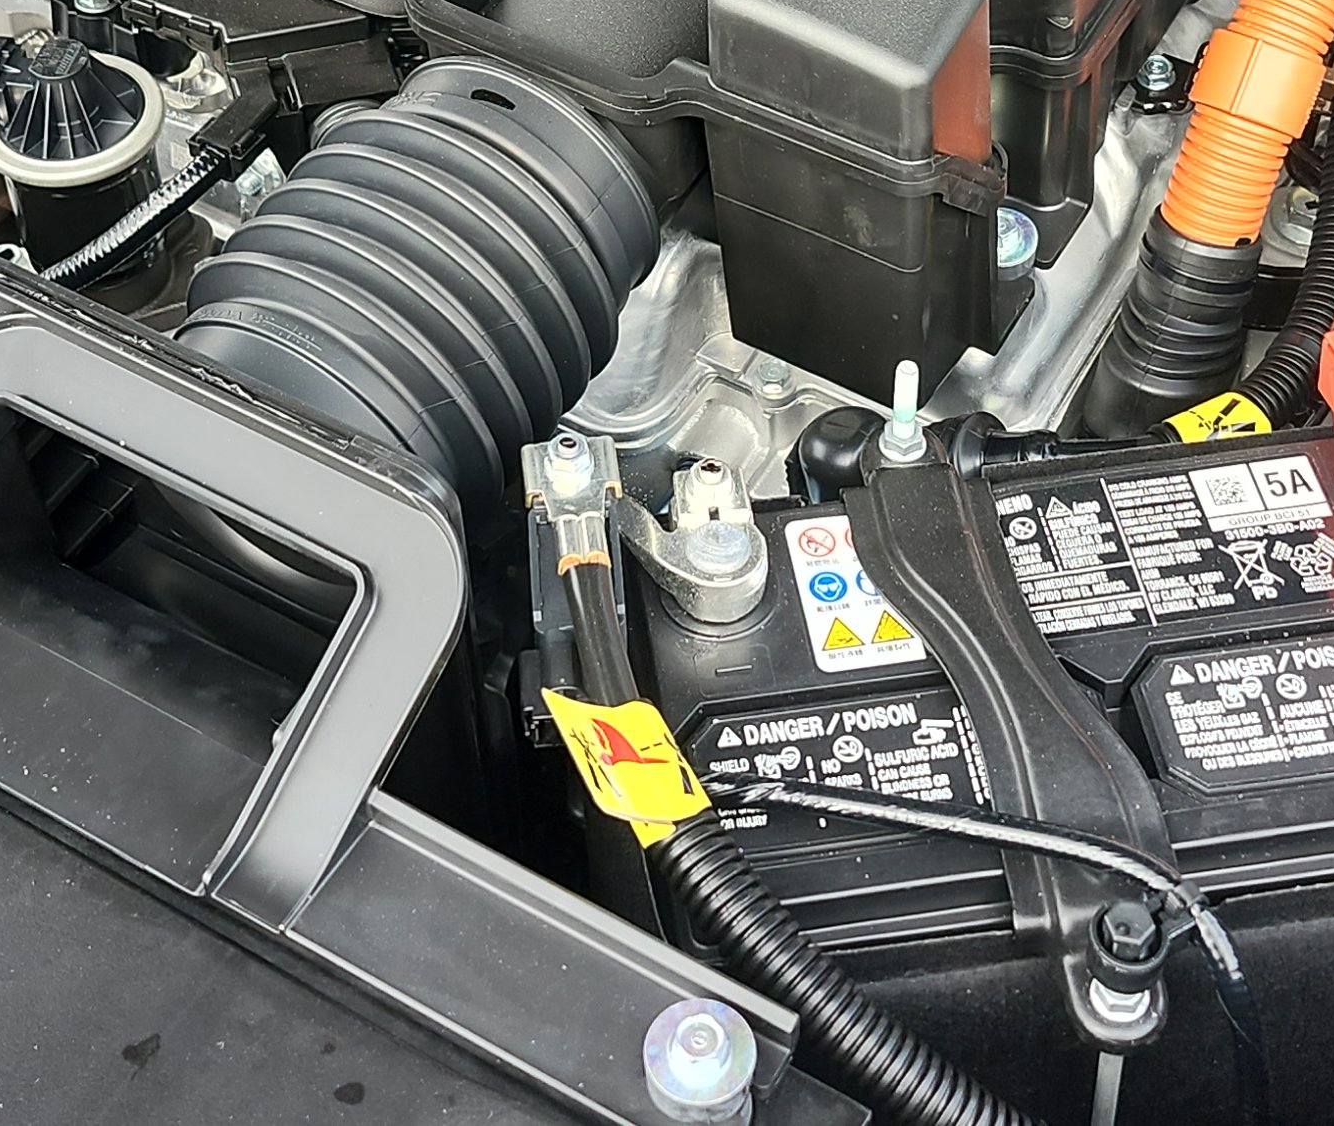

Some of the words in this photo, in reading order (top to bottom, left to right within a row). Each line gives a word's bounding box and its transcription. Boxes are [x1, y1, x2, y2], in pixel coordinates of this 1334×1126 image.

[1264, 468, 1314, 497] 5A
[1228, 514, 1271, 526] GROUP
[1275, 511, 1295, 521] BCI
[1297, 509, 1311, 517] 51
[1052, 527, 1080, 540] PUEDE
[1080, 521, 1115, 535] CAUSAR
[1224, 518, 1326, 541] 31500-3B0-A02
[1056, 535, 1094, 550] CEGUERA
[1059, 541, 1118, 558] QUEMADURAS
[1131, 540, 1196, 558] MANUFACTURED
[1195, 538, 1214, 550] FOR
[1175, 551, 1202, 564] POUR:
[1188, 574, 1202, 586] CA
[1061, 587, 1081, 600] CON
[1080, 586, 1093, 597] EL
[1197, 584, 1216, 596] LLC
[1252, 585, 1278, 600] Pb
[1165, 691, 1184, 706] SE
[1279, 700, 1326, 719] AUCUNE
[1173, 718, 1198, 734] LES
[875, 747, 930, 767] SULFURIC
[930, 742, 959, 759] ACID
[1235, 740, 1250, 753] LA
[709, 757, 750, 773] SHIELD
[821, 758, 841, 774] NO
[1202, 758, 1218, 770] OU
[1217, 755, 1236, 769] DES
[878, 767, 899, 781] CAN
[898, 763, 931, 779] CAUSE
[881, 776, 933, 793] BLINDNESS
[932, 773, 950, 787] OR
[920, 787, 953, 800] BURNS
